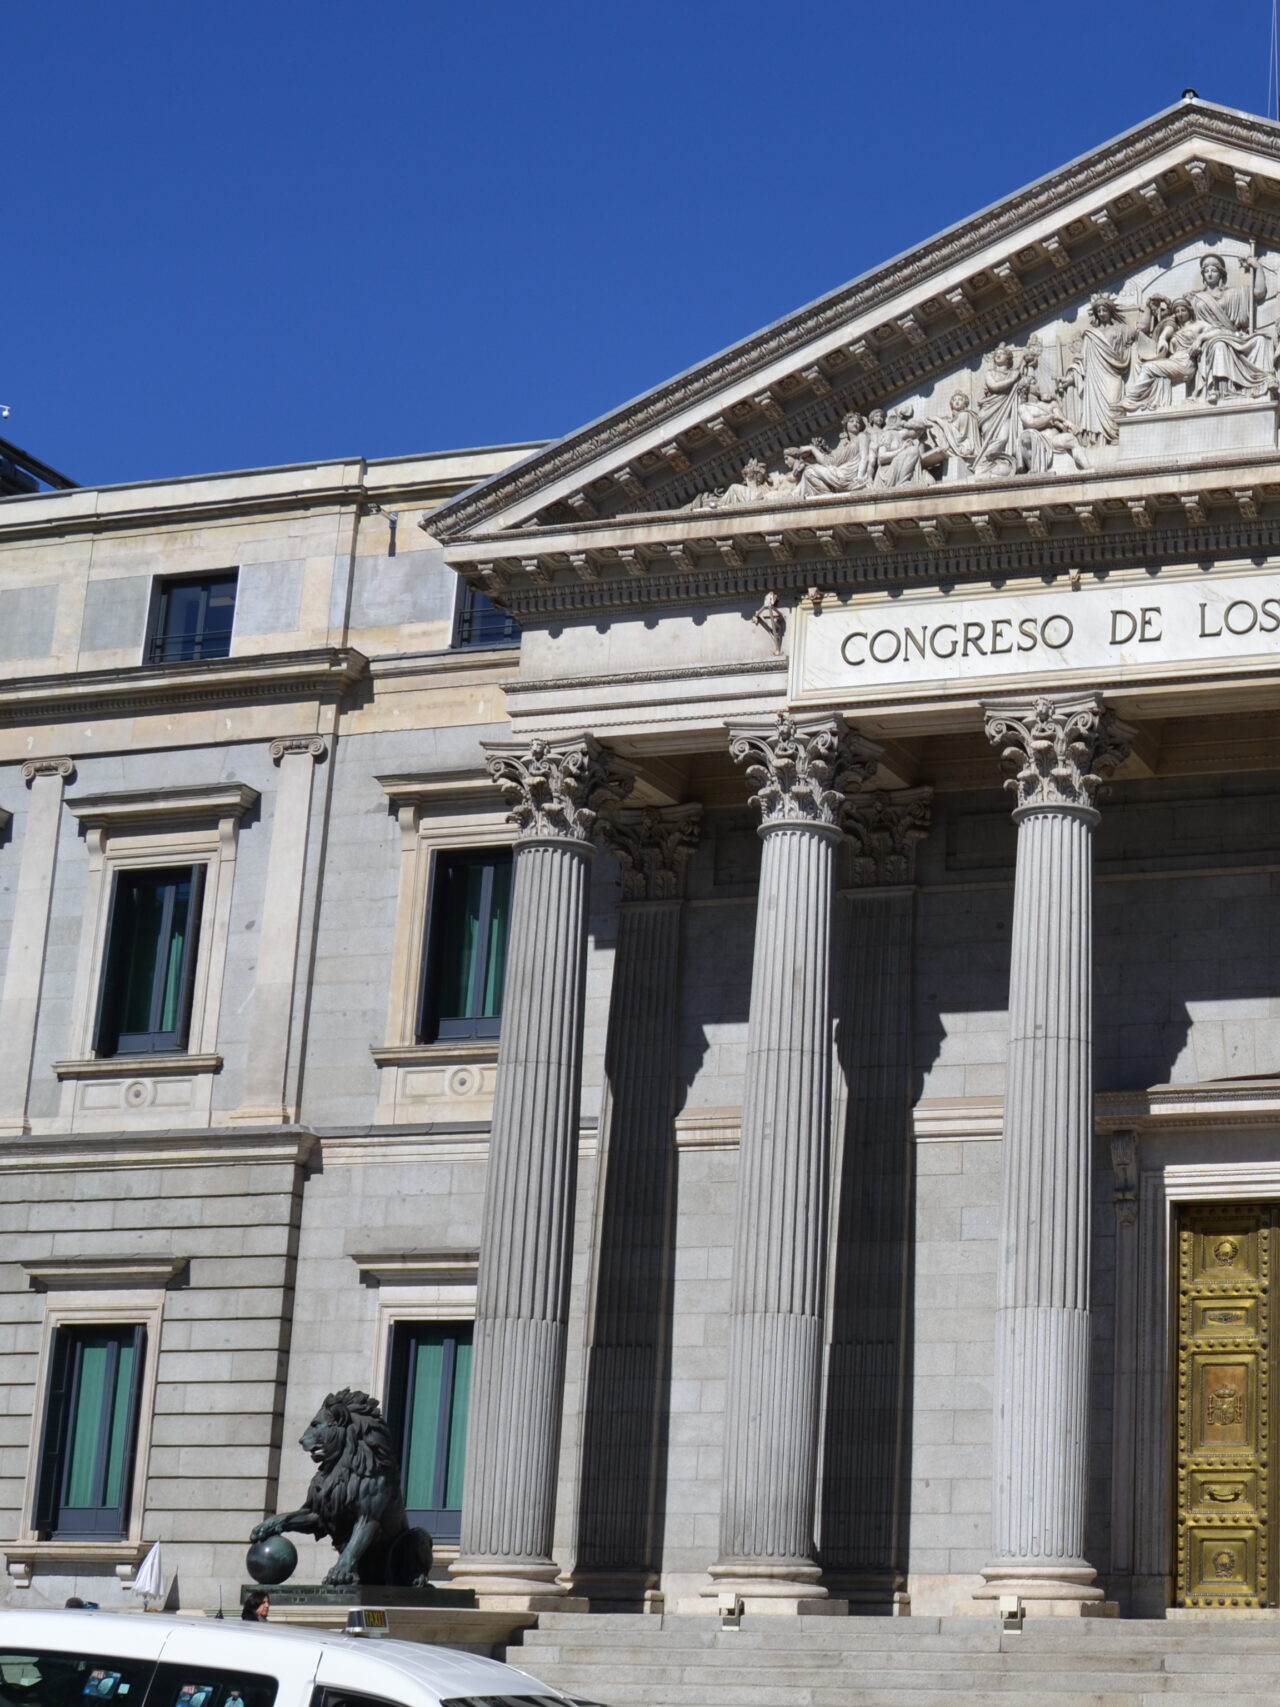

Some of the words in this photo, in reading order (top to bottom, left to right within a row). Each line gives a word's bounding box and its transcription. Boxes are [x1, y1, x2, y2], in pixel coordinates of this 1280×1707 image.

[840, 614, 1074, 666] CONGRESO
[1109, 607, 1163, 645] DE
[1199, 598, 1280, 637] LOS
[364, 1610, 382, 1626] TAXI
